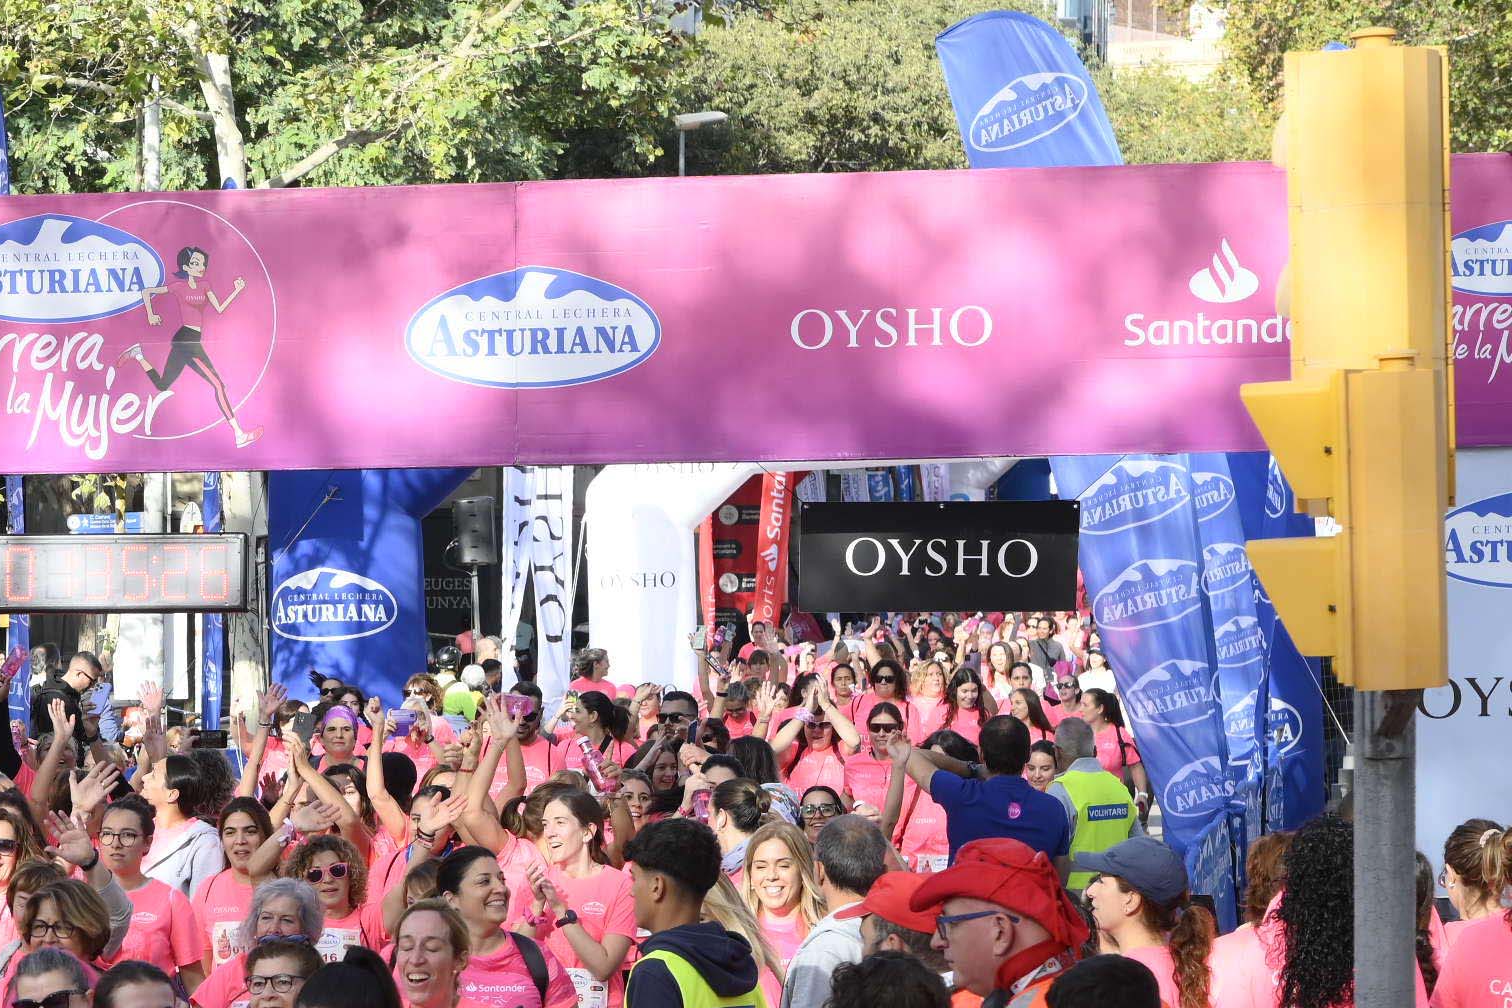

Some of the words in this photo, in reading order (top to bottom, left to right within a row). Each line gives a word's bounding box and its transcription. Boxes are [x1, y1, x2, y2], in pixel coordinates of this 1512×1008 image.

[61, 250, 141, 263] LECHERA
[464, 307, 544, 322] CENTRAL
[551, 305, 634, 320] LECHERA
[790, 305, 993, 351] OYSHO
[428, 314, 641, 358] ASTURIANA
[1474, 332, 1492, 360] la
[6, 376, 32, 415] la
[25, 366, 175, 461] Mujer
[845, 537, 1039, 577] OYSHO
[275, 597, 389, 626] ASTURIANA
[1417, 677, 1512, 719] OY
[1088, 807, 1127, 817] VOLUNTARIS
[478, 983, 526, 993] Santander
